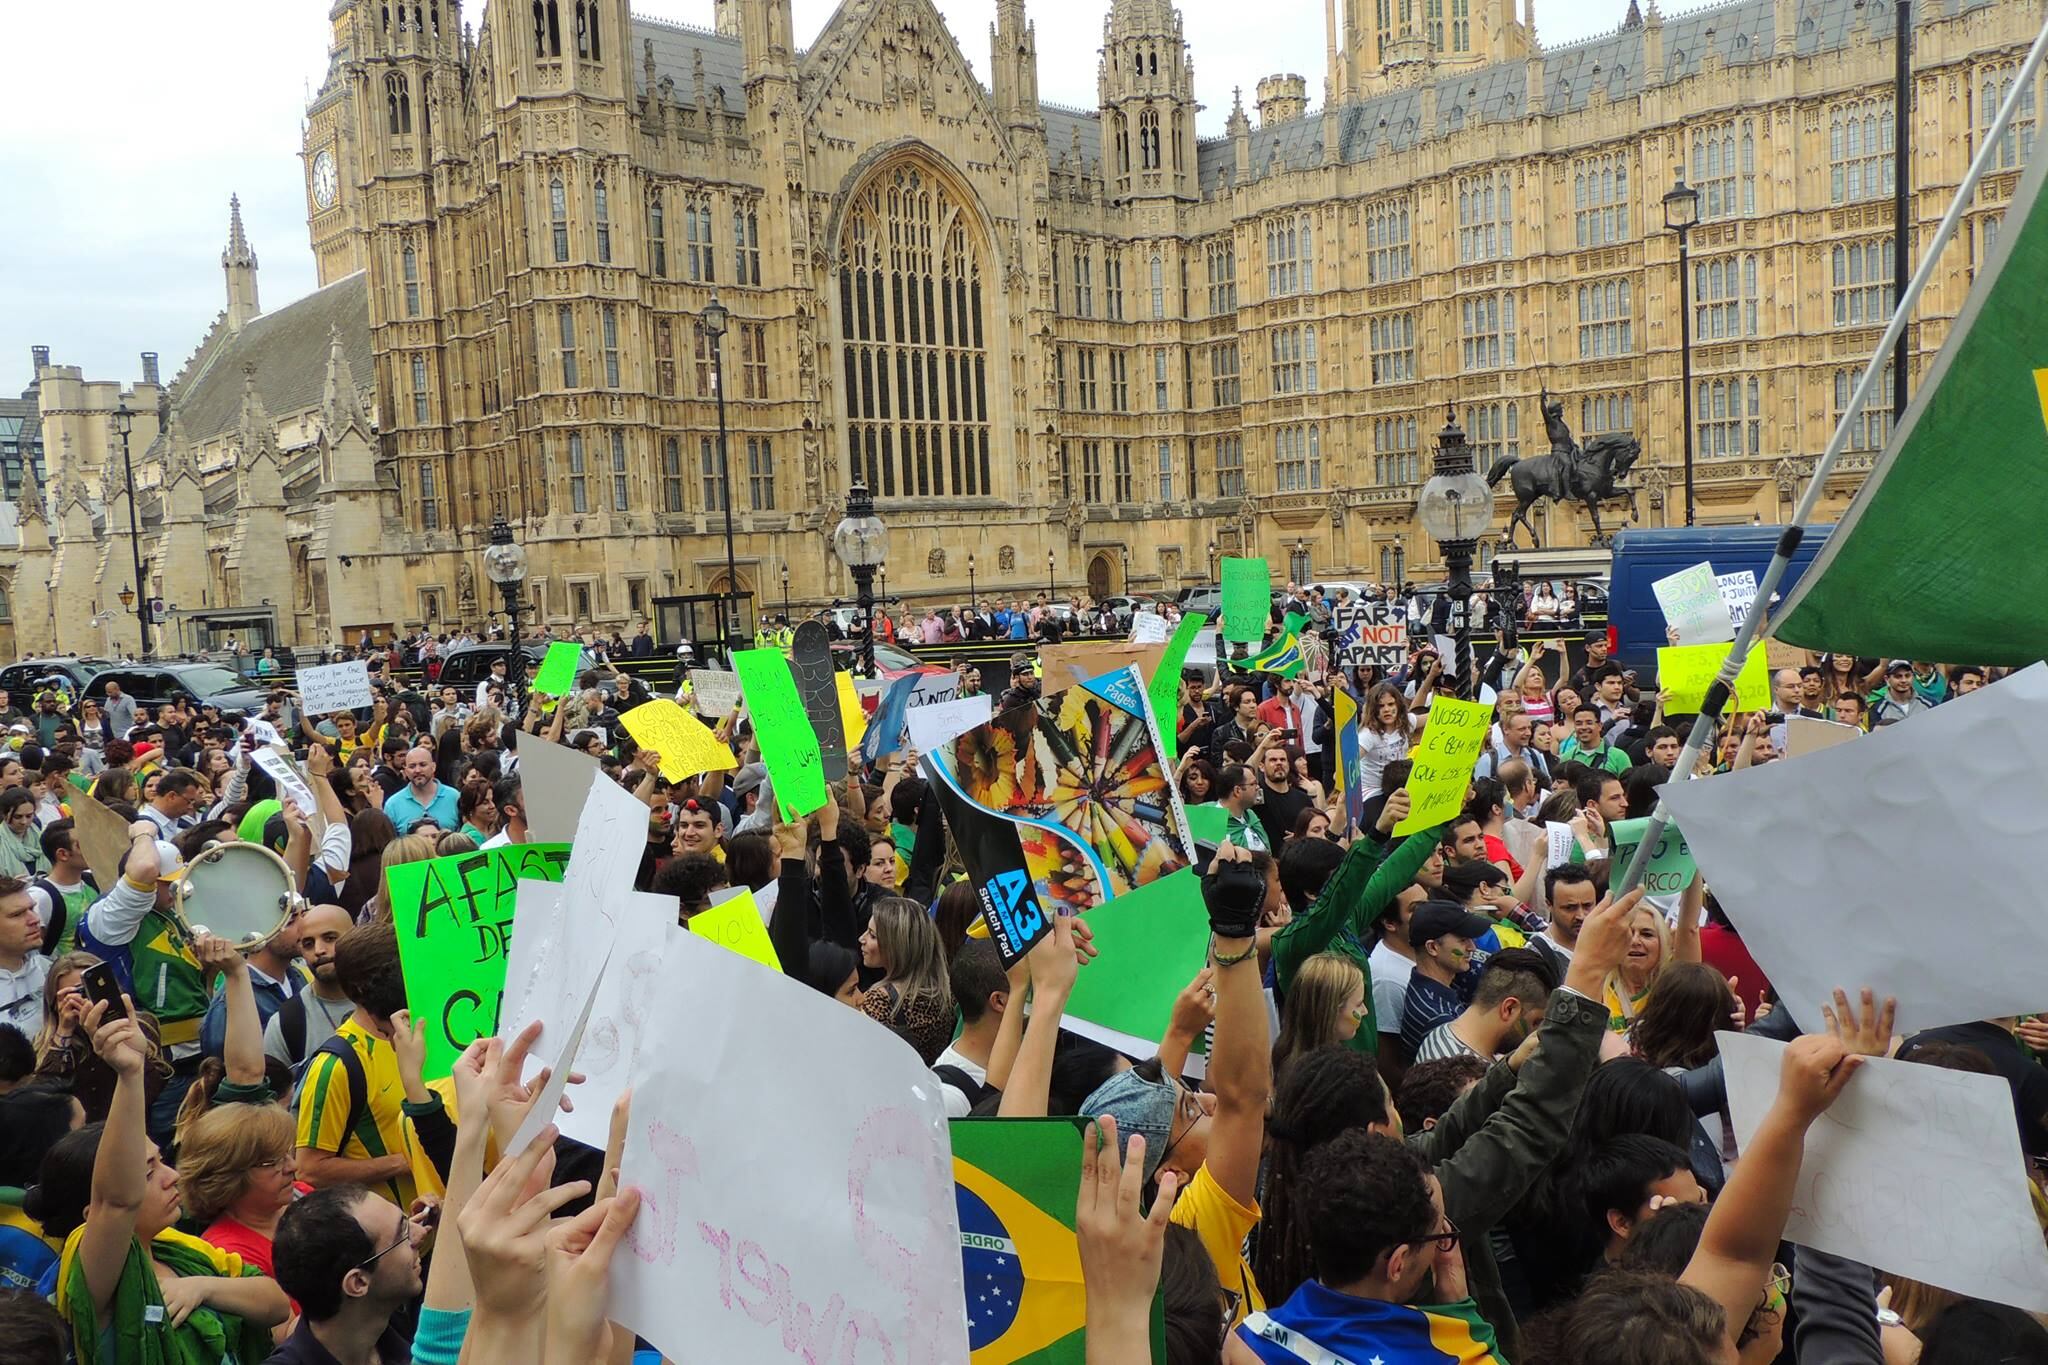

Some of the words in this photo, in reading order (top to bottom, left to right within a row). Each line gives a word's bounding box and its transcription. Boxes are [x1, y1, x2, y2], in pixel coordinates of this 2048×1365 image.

[1657, 566, 1710, 601] STOP
[1716, 573, 1754, 588] LONGE
[1729, 586, 1758, 600] JUNTO
[1336, 607, 1389, 629] FAR
[1362, 625, 1405, 645] NOT
[1336, 645, 1406, 665] APART
[1103, 683, 1137, 709] Pages
[1431, 705, 1470, 728] NOSSO
[1413, 764, 1438, 782] QUE
[1553, 831, 1561, 861] UNITED
[1618, 839, 1669, 865] PO
[988, 881, 1021, 950] PREMIUM
[996, 868, 1042, 941] A3
[978, 887, 1001, 932] Sketch
[996, 932, 1014, 958] Pad
